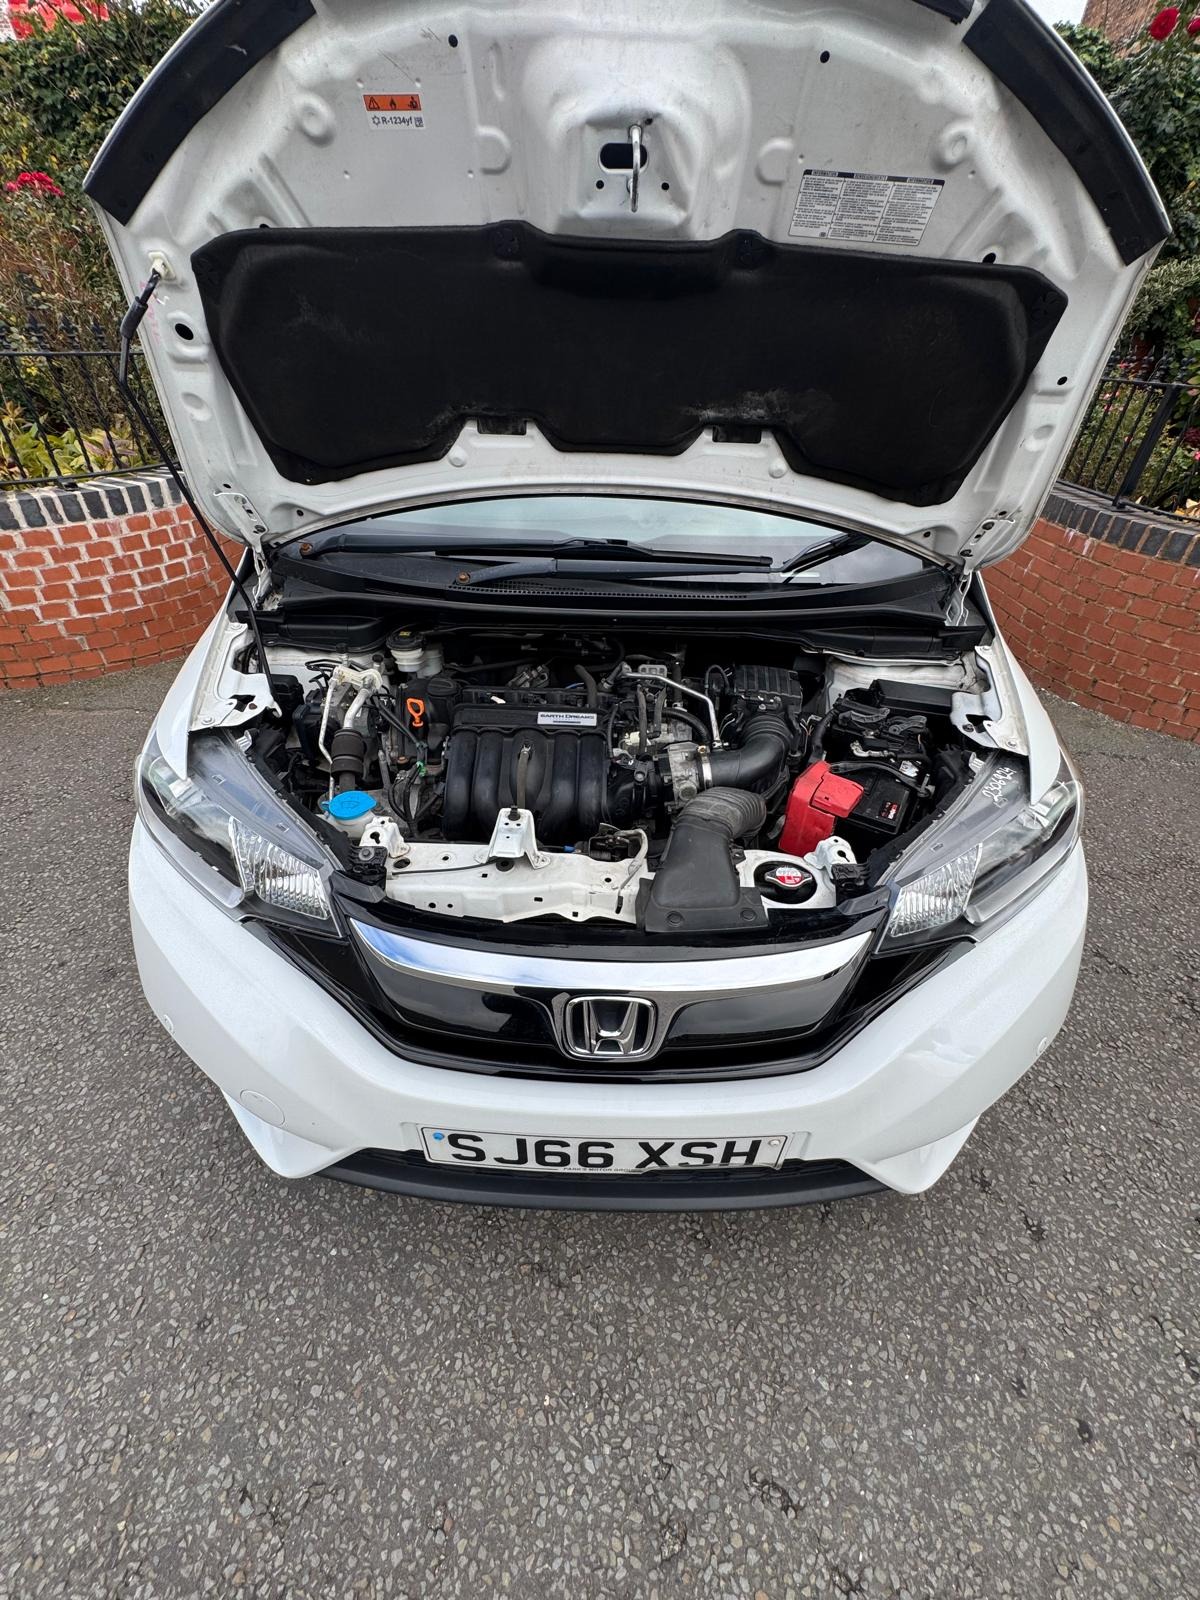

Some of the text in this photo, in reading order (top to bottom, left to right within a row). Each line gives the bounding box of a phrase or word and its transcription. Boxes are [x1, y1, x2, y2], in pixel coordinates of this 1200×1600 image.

[381, 116, 413, 126] R-1234yf
[447, 1133, 762, 1168] SJ66 XSH
